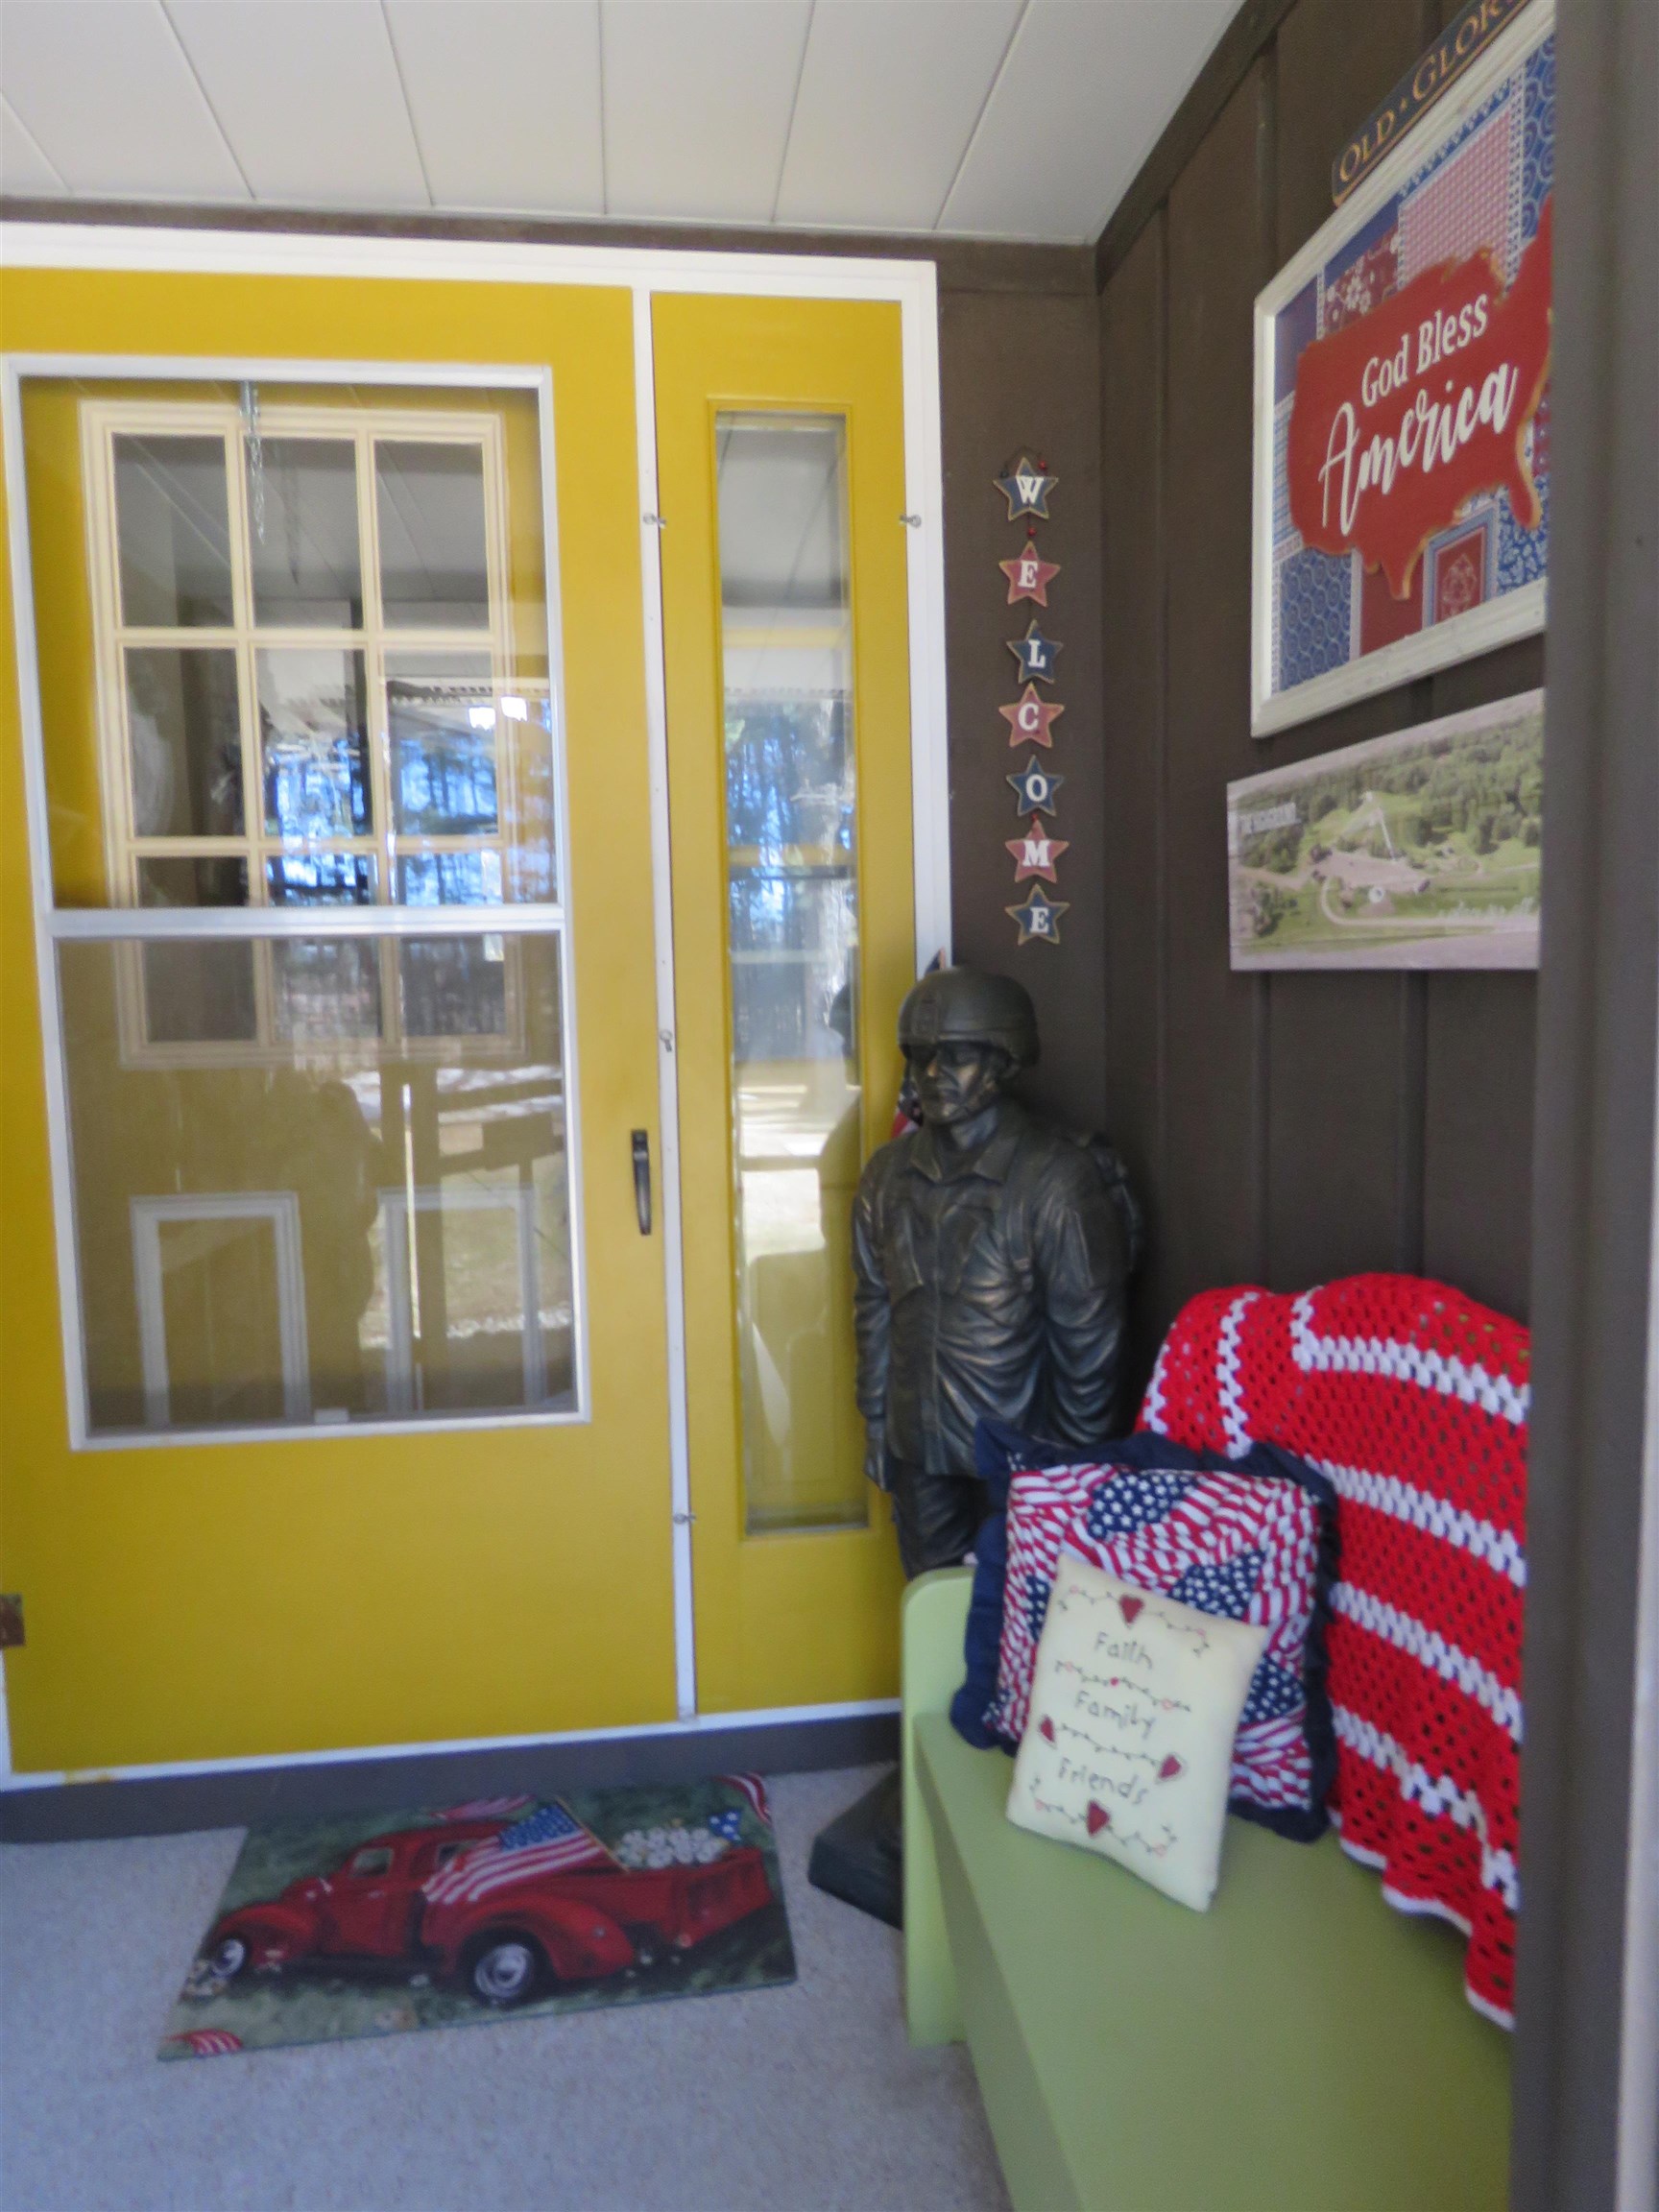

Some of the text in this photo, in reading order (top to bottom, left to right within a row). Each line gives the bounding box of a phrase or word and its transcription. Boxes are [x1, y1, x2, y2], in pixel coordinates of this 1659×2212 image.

[1338, 0, 1514, 183] OLD GLOR
[1361, 294, 1487, 407] God Bless
[1318, 363, 1519, 536] America
[1014, 474, 1050, 933] WELCOME
[1094, 1631, 1154, 1670] Faith
[1074, 1690, 1157, 1741] Family
[1058, 1756, 1150, 1806] Friends
